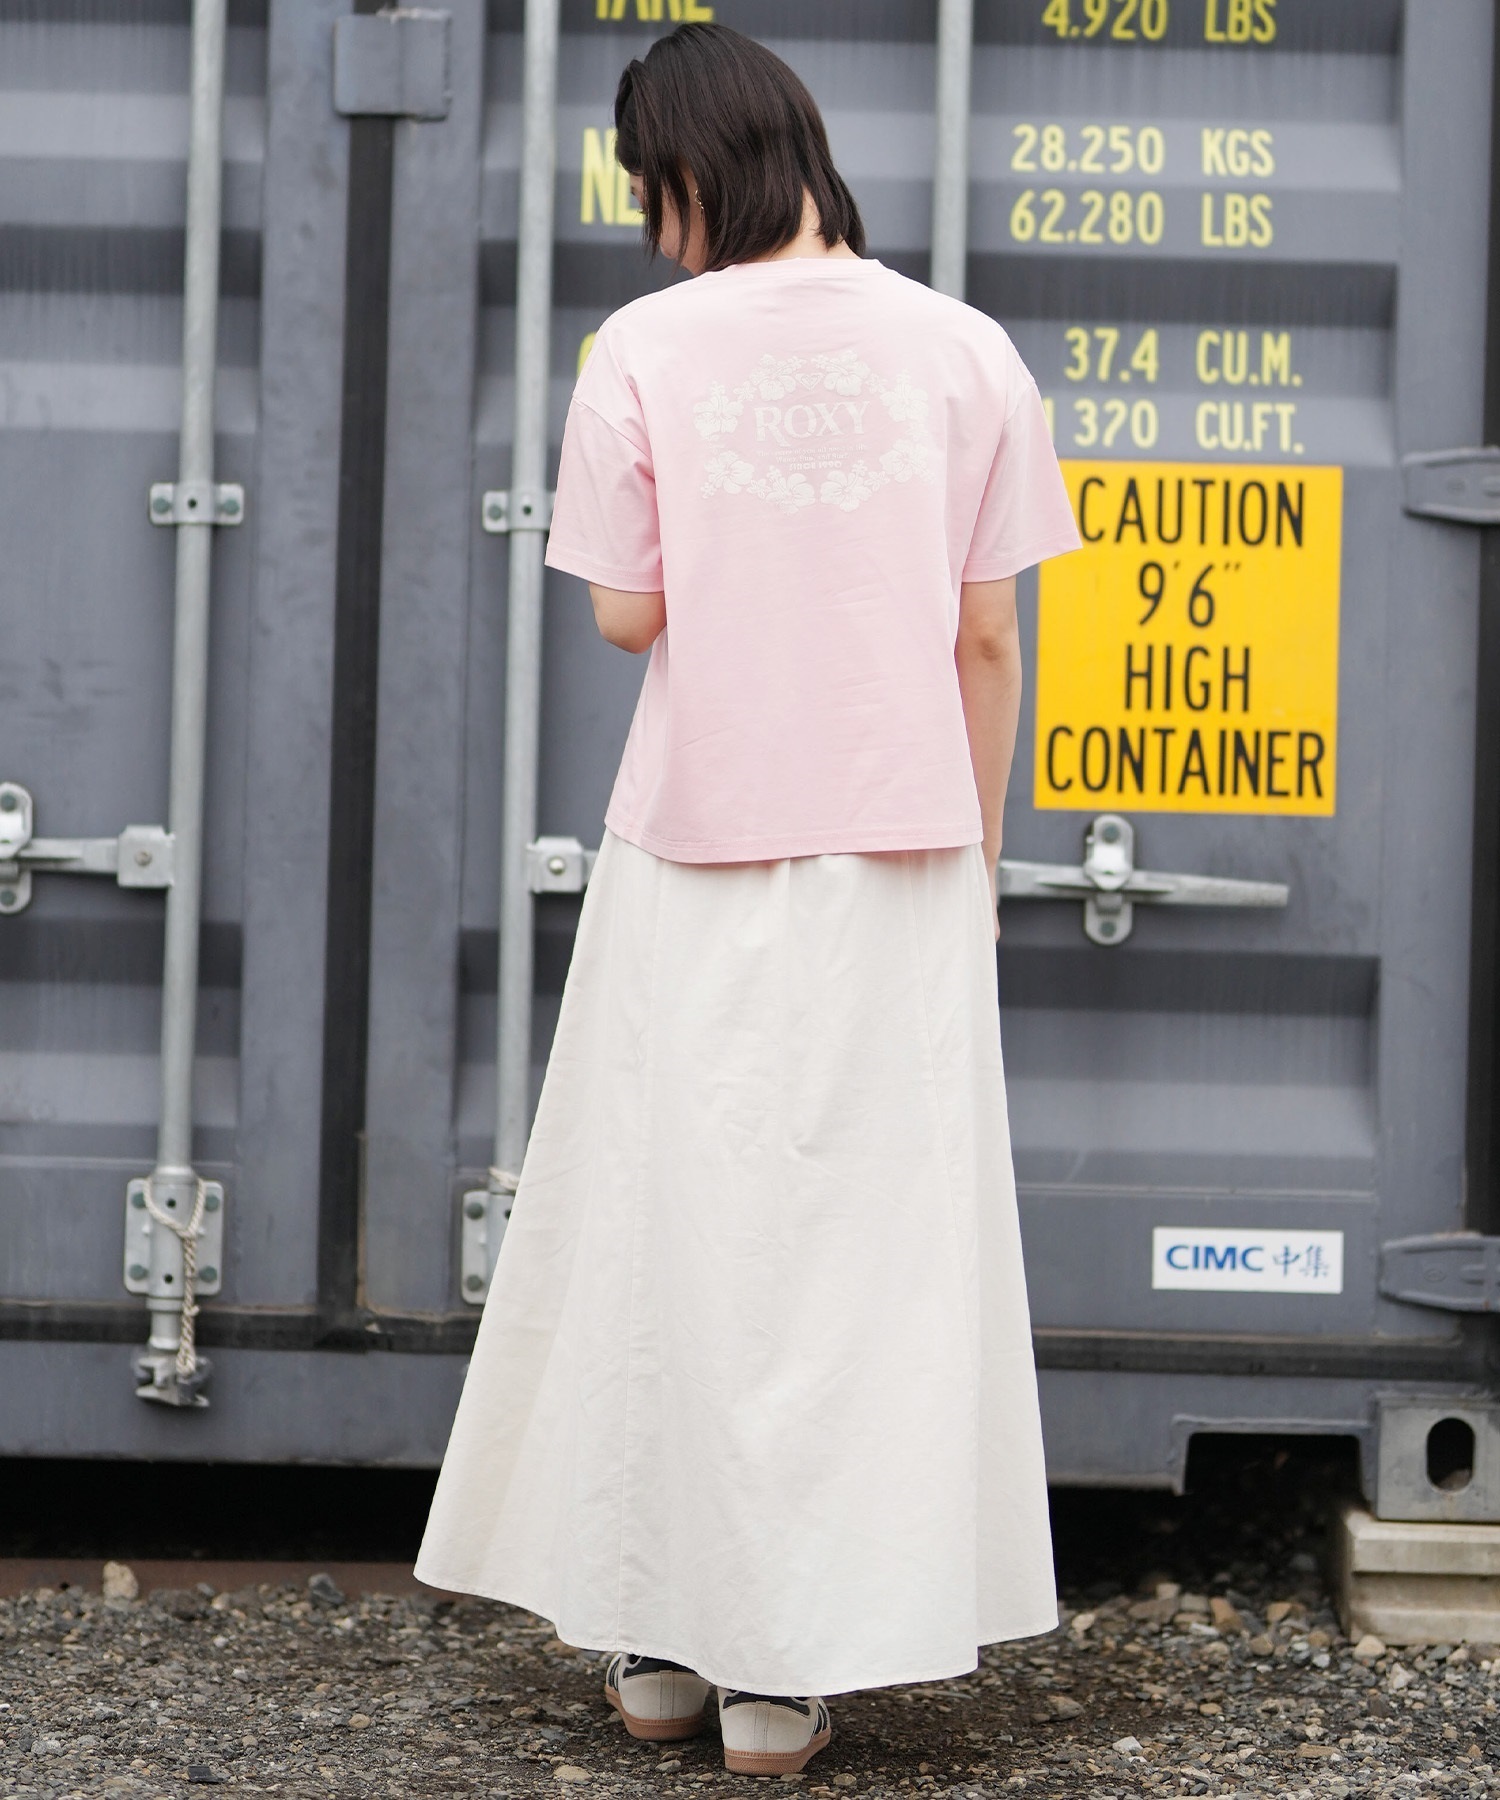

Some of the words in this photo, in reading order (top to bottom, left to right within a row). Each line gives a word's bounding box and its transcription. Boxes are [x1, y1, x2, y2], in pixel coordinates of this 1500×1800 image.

[1041, 0, 1168, 40] 4.920
[1204, 0, 1277, 43] LBS
[1010, 123, 1165, 174] 28.250
[1202, 127, 1275, 177] KGS
[1009, 188, 1165, 245] 62.280
[1201, 192, 1273, 247] LBS
[1064, 327, 1159, 383] 37.4
[1196, 330, 1303, 387] CU.M.
[753, 401, 870, 447] ROXY
[1196, 401, 1304, 454] CU.FT.
[1079, 477, 1304, 547] CAUTION
[1125, 643, 1250, 713] HIGH
[1047, 725, 1325, 798] CONTAINER
[1165, 1244, 1265, 1272] CIMC
[1272, 1244, 1330, 1279] 中集
